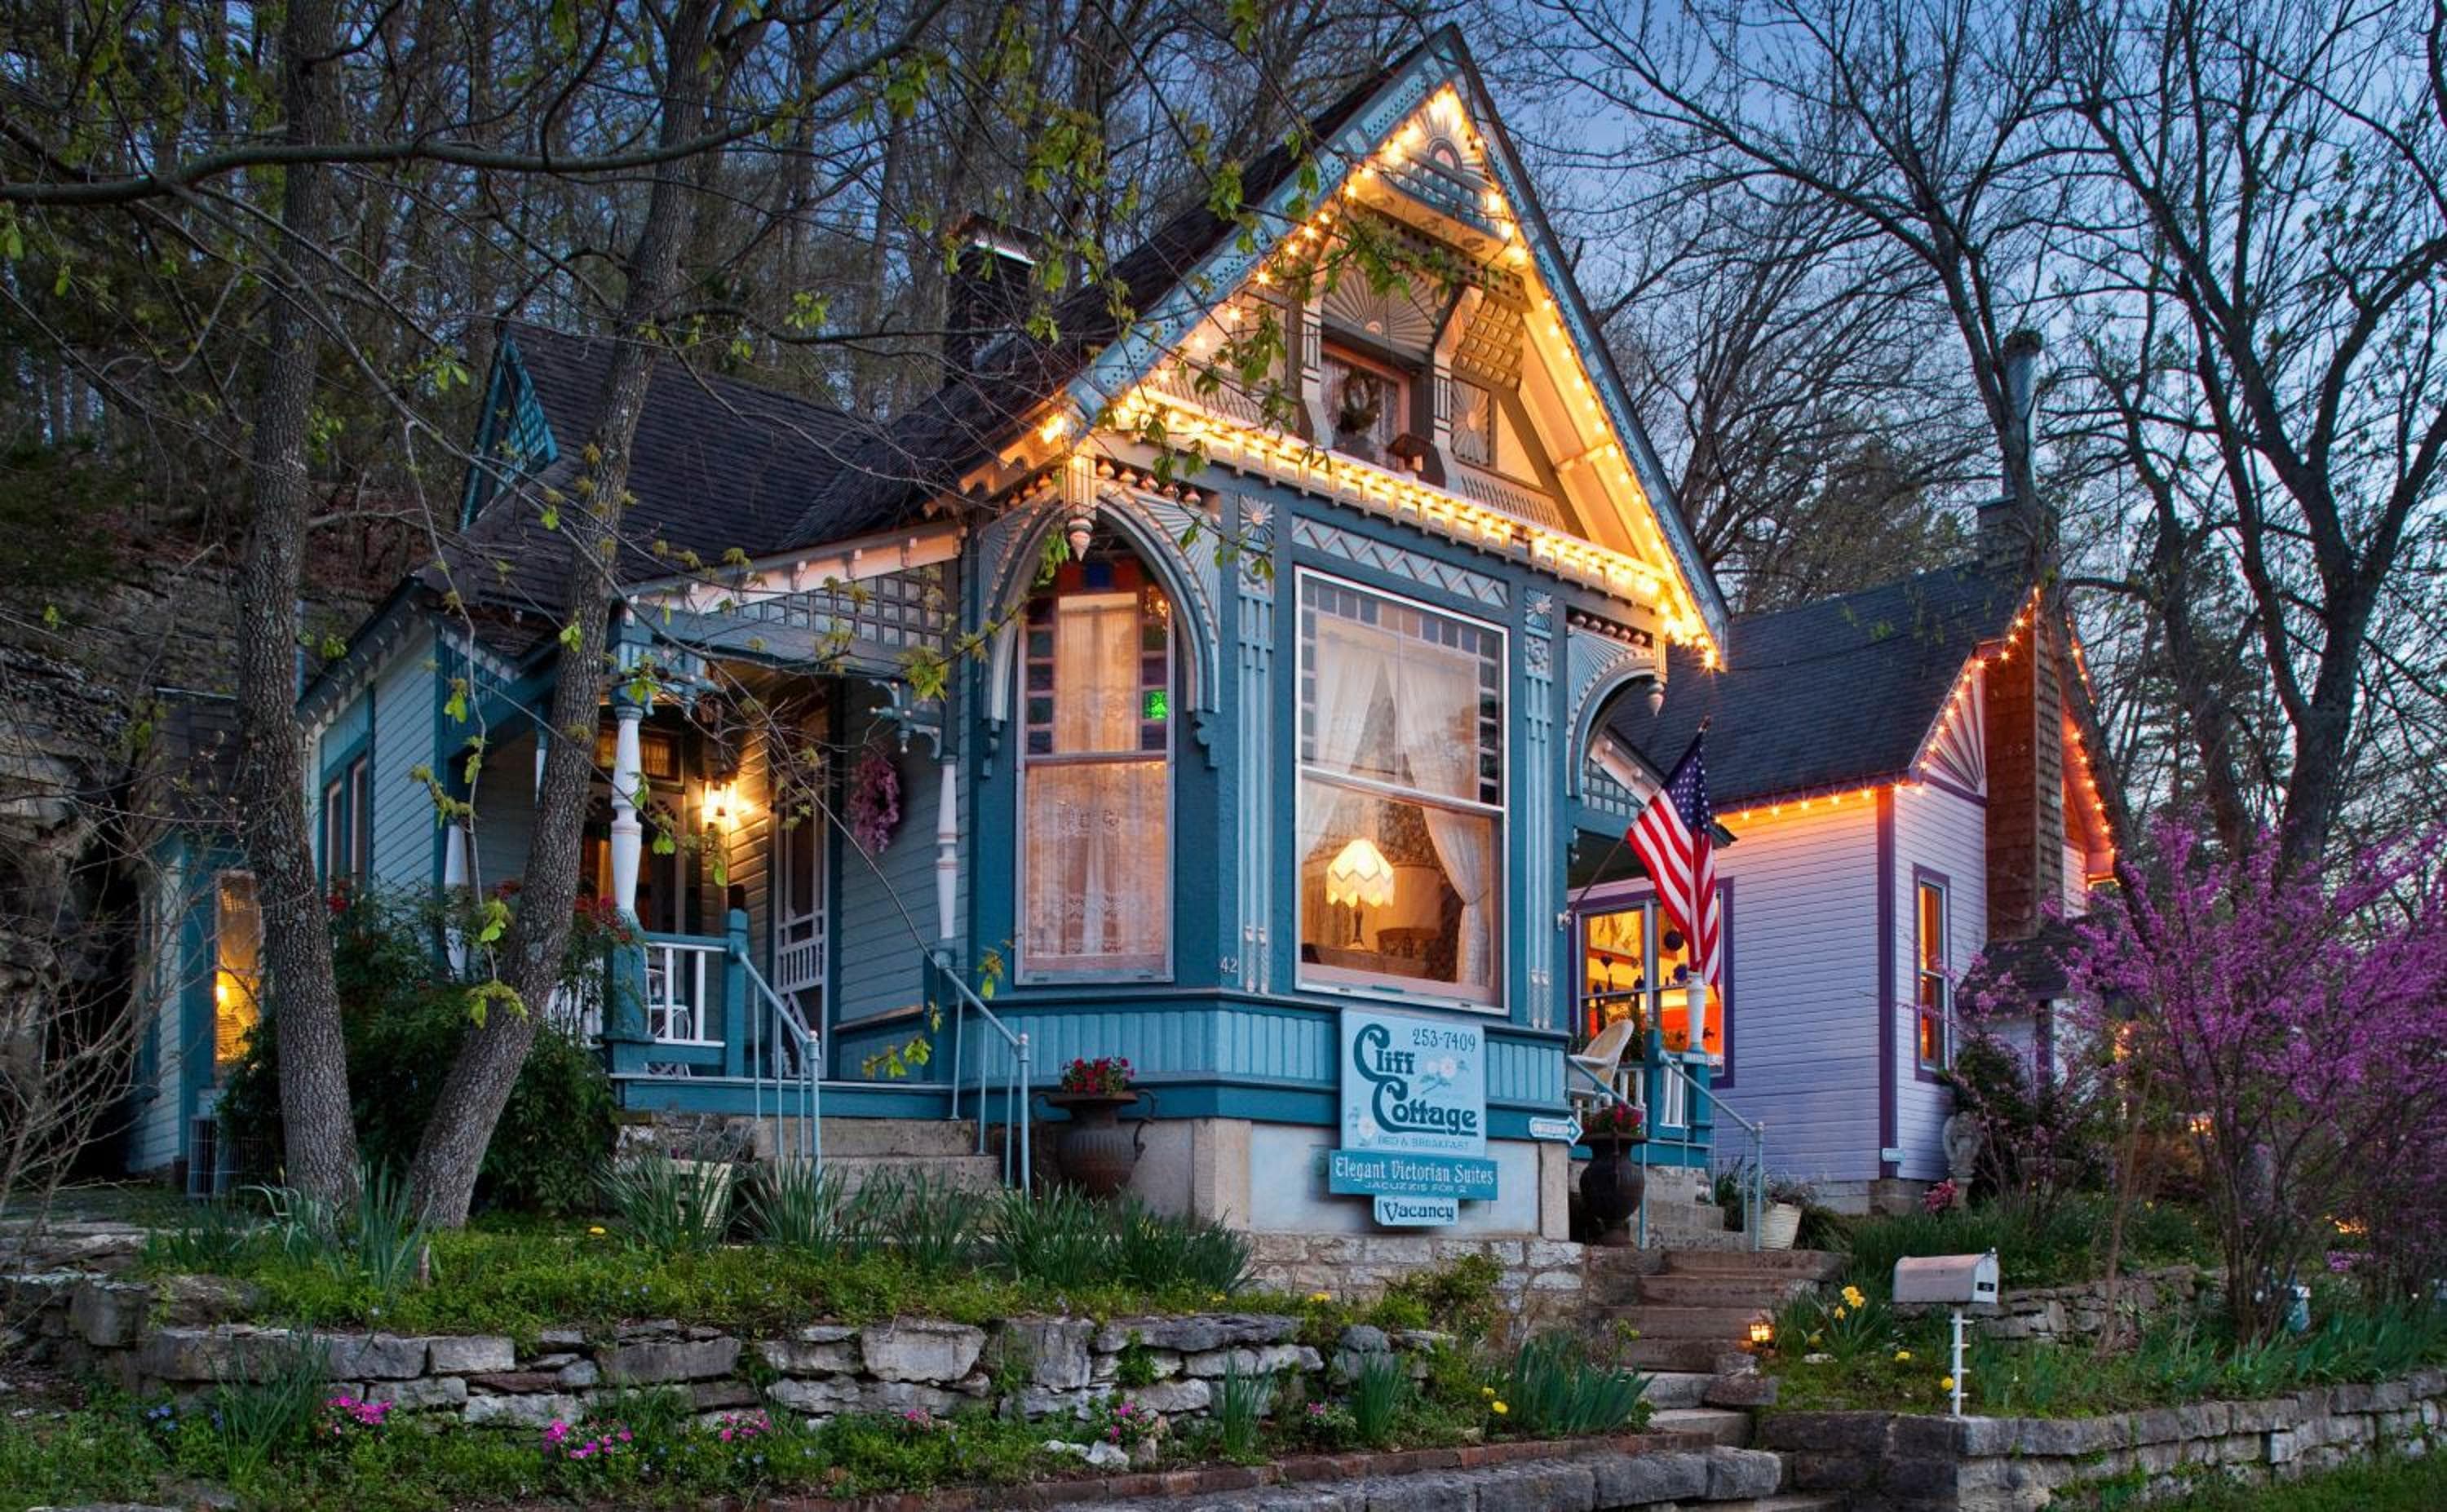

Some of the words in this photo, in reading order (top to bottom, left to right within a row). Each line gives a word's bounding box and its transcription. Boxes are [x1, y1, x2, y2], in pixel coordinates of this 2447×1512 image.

[1220, 956, 1238, 973] 42
[1353, 1023, 1415, 1082] Cliff
[1412, 1028, 1476, 1053] 253-7409
[1372, 1075, 1478, 1137] Cottage
[1335, 1156, 1386, 1182] Elegant
[1392, 1159, 1449, 1183] Victorian
[1454, 1163, 1494, 1186] Suites
[1431, 1183, 1454, 1192] FOR
[1383, 1201, 1455, 1222] Vacancy
